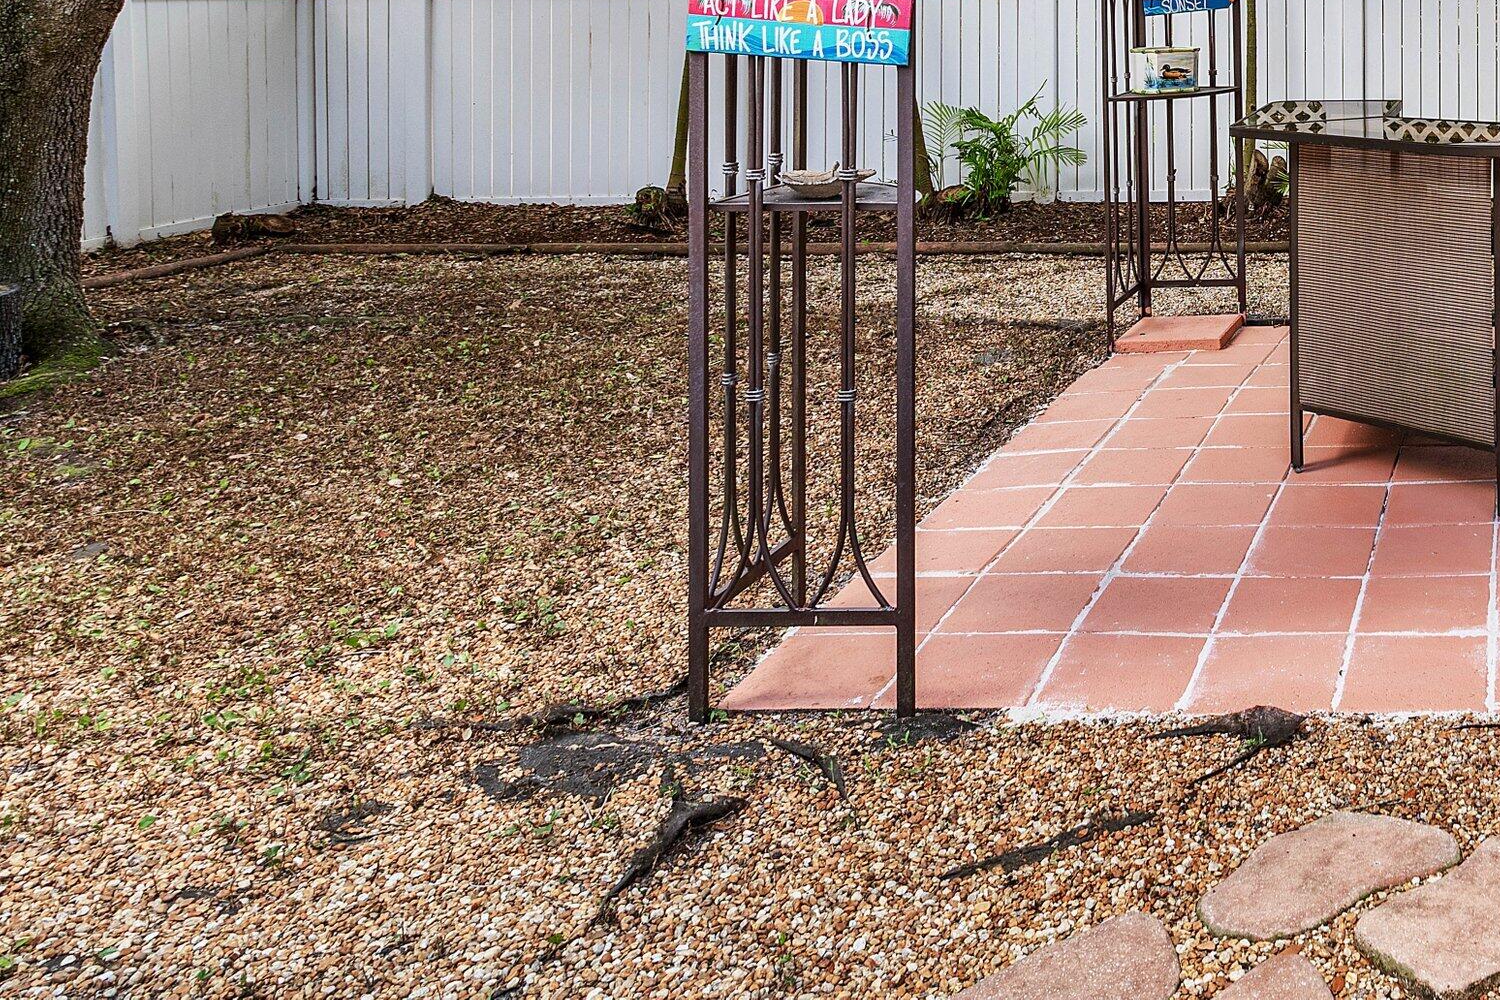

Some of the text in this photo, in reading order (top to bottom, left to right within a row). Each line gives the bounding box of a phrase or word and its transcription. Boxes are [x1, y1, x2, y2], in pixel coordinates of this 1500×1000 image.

[692, 21, 894, 60] THINK LIKE A BOSS
